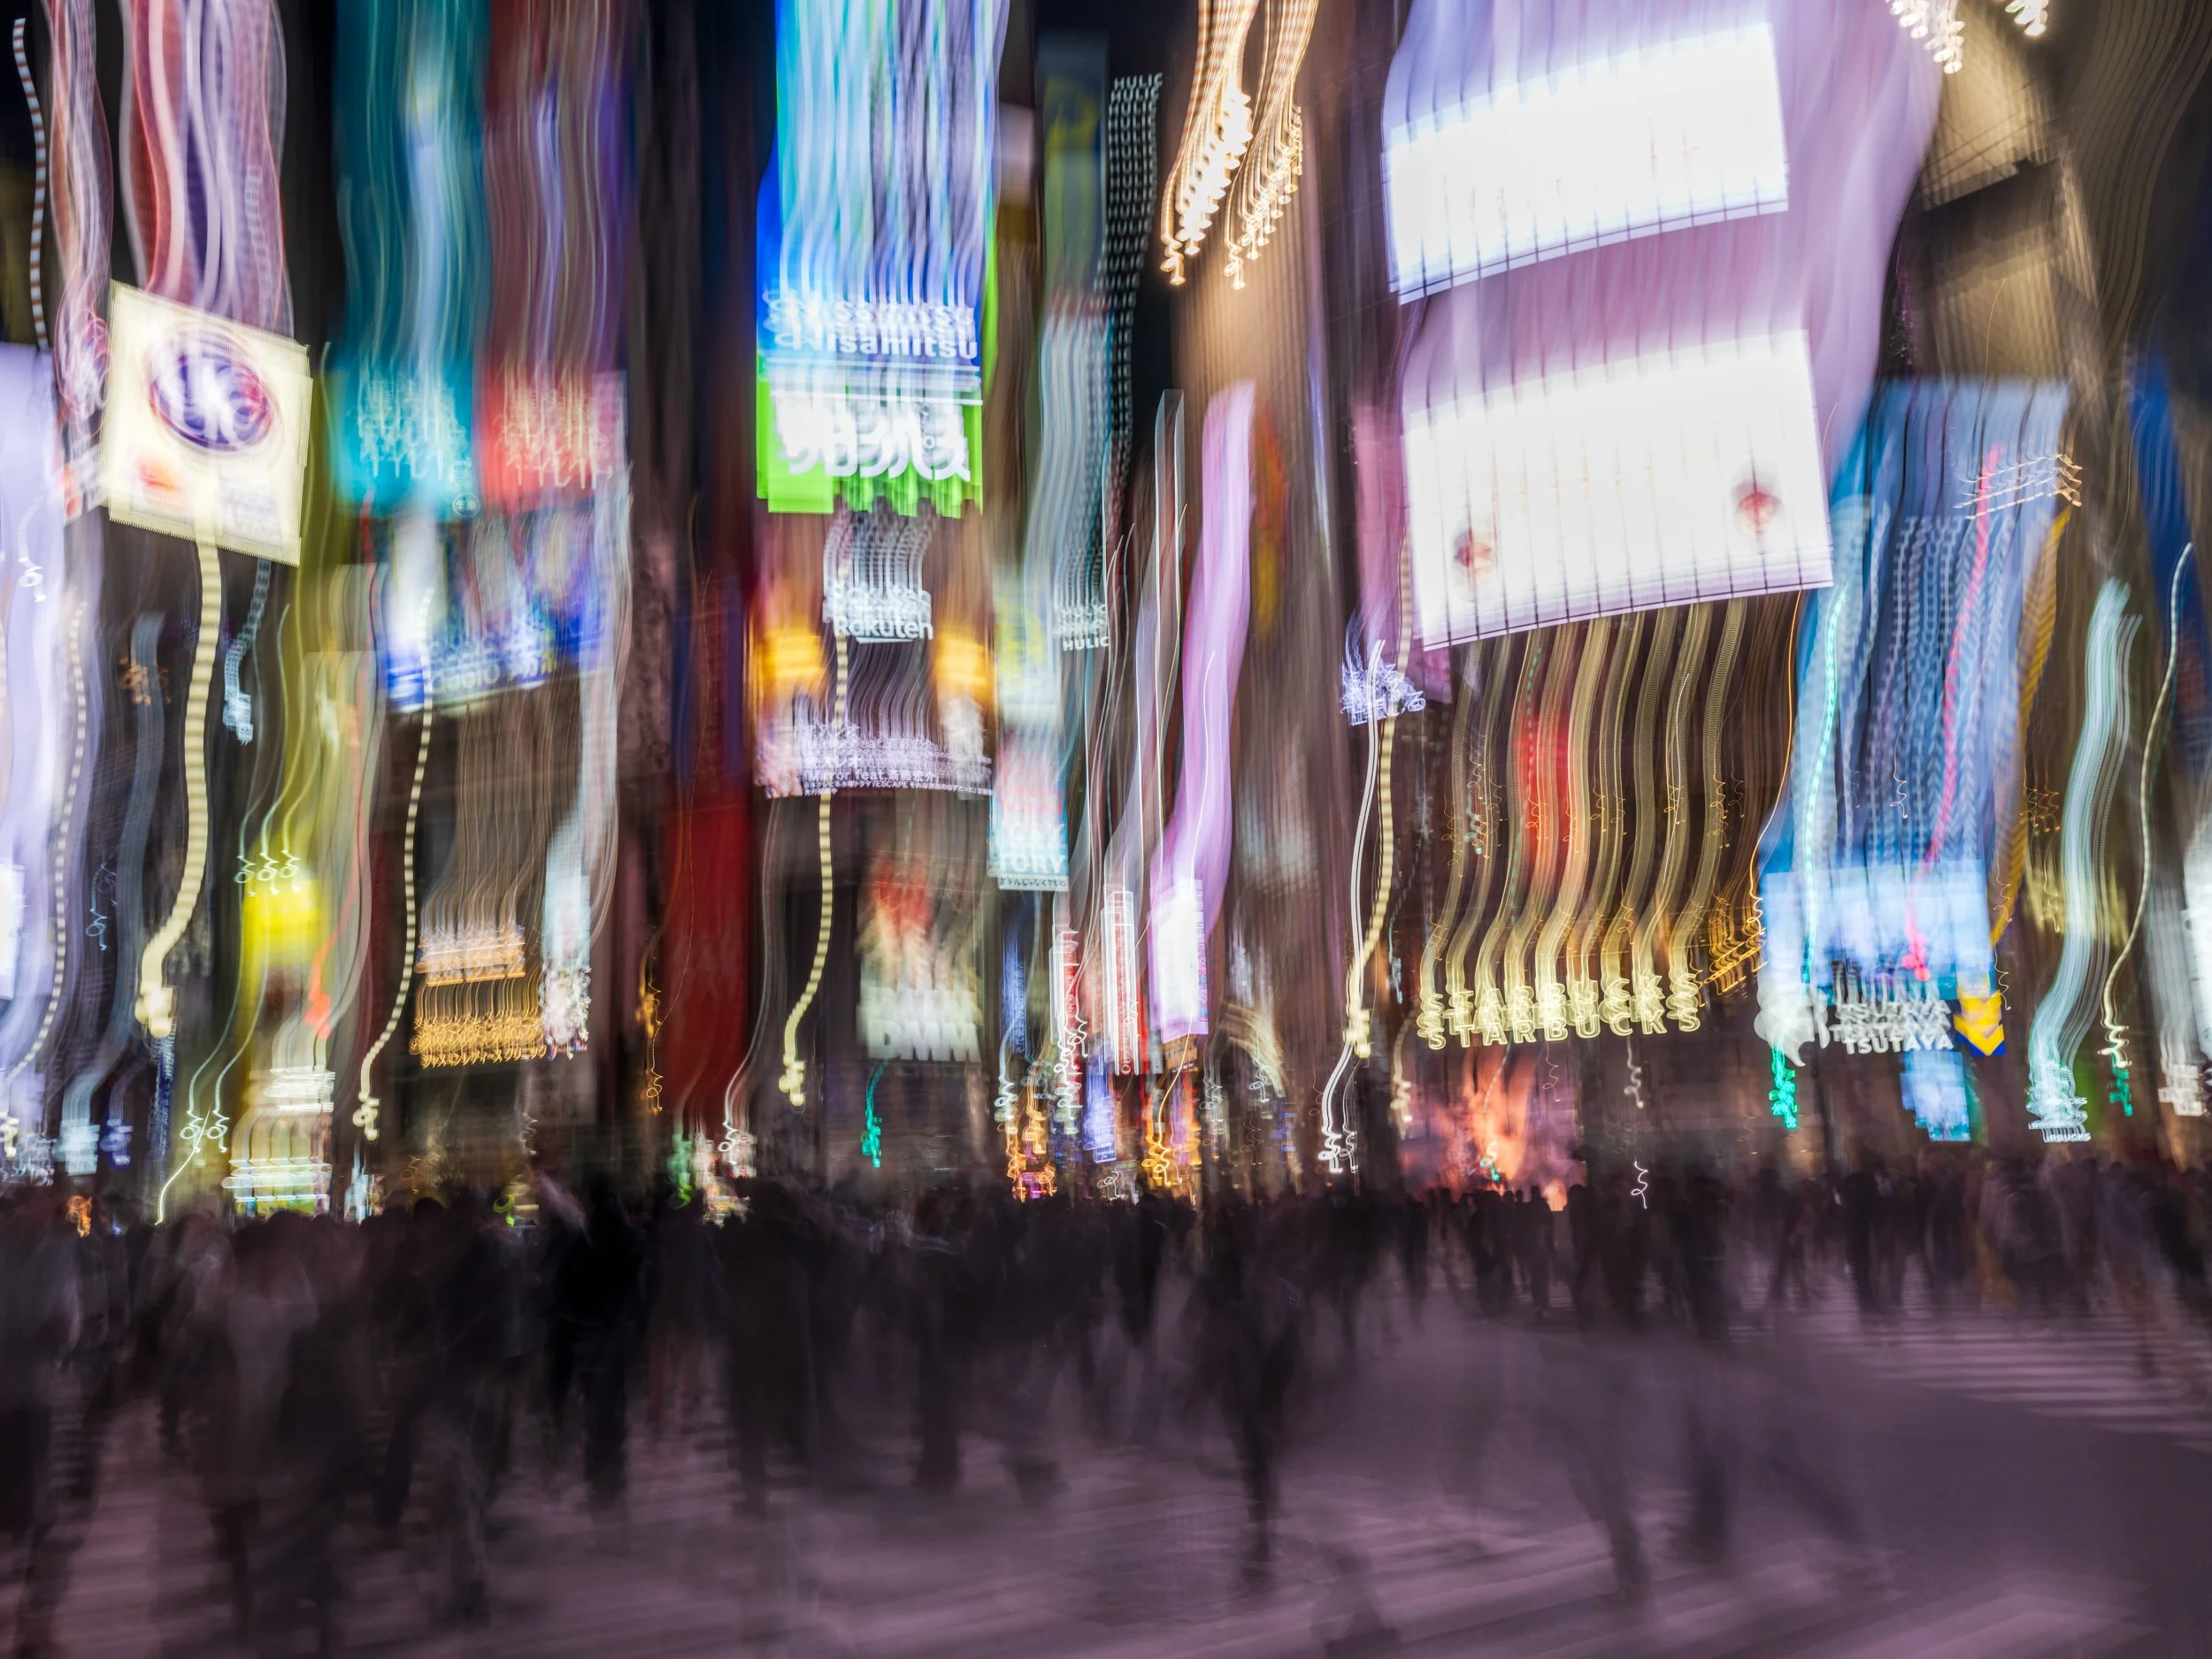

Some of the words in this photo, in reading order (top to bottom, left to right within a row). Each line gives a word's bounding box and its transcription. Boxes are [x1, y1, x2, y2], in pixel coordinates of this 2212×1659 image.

[1114, 73, 1164, 89] HULIC
[833, 616, 933, 641] Rakuten
[1063, 636, 1110, 651] HULIC
[1427, 1006, 1701, 1051] STARBUCKS
